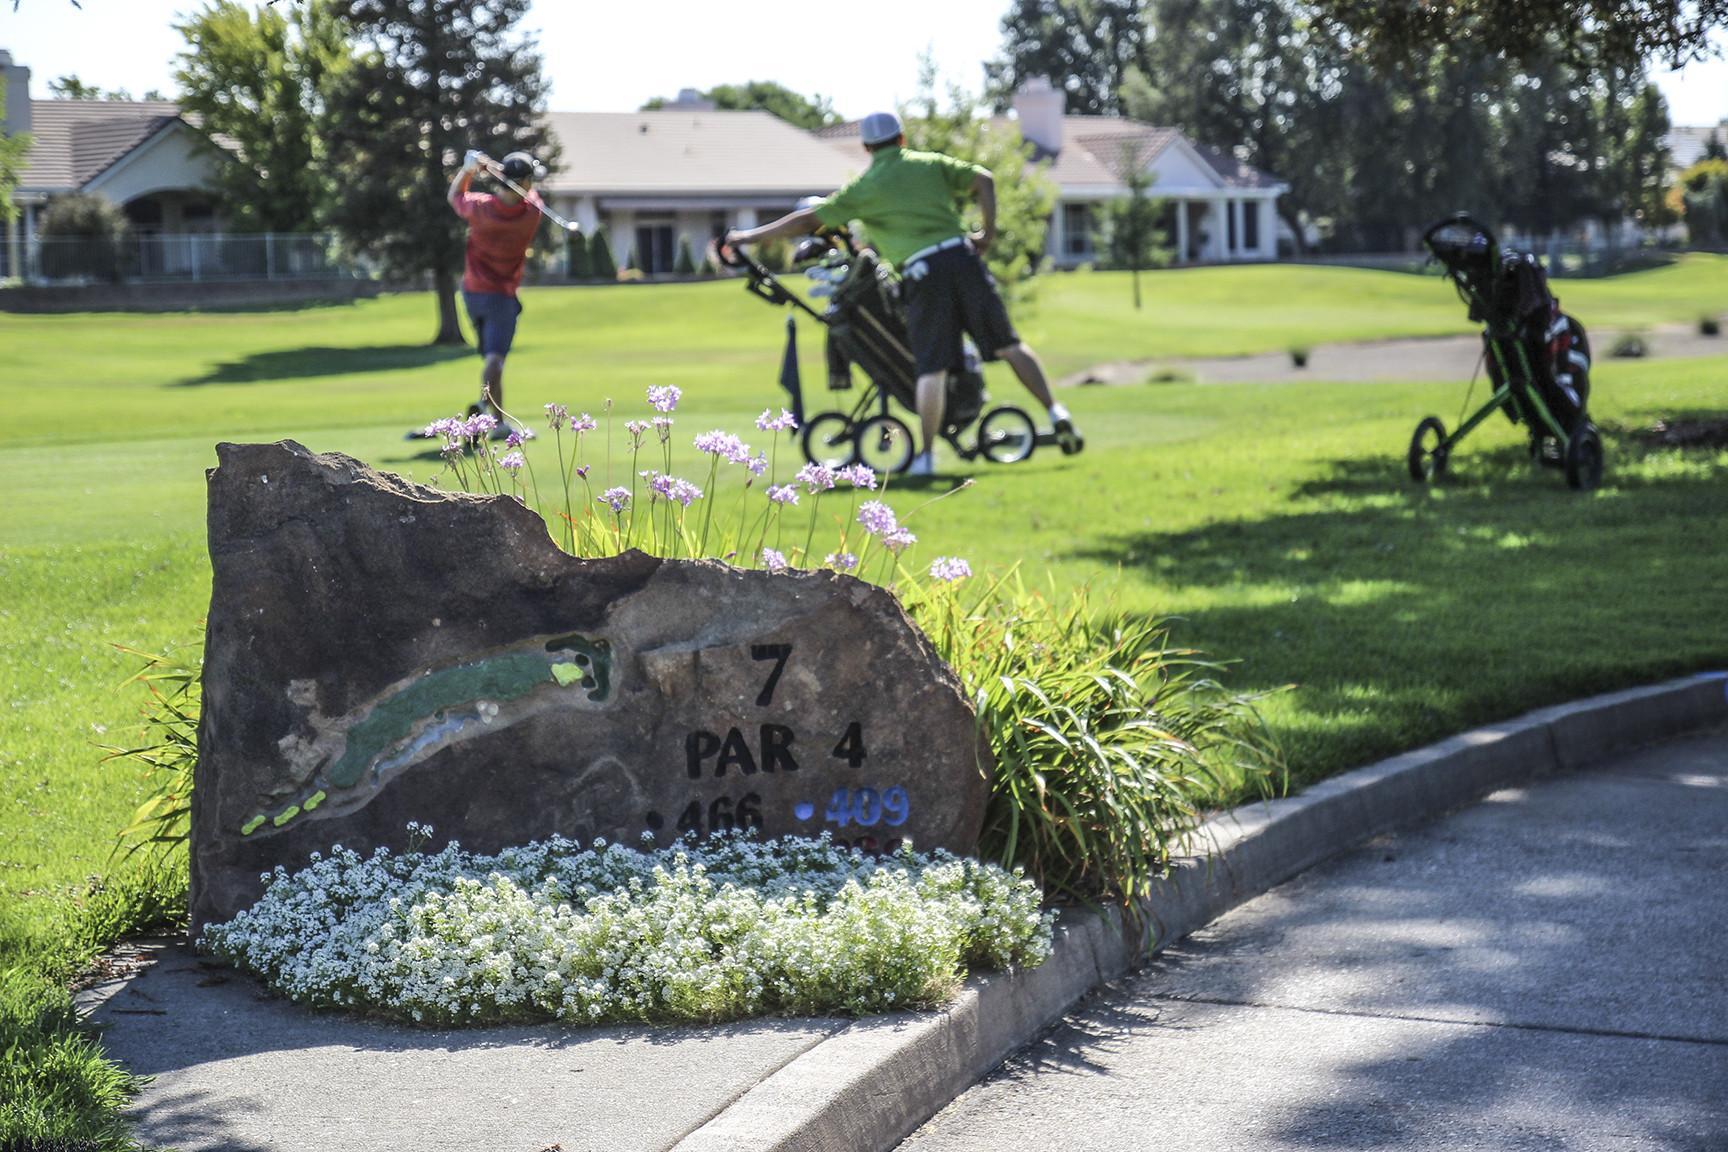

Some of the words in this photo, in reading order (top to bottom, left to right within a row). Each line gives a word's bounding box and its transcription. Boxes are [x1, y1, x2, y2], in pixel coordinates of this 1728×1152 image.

[751, 643, 793, 707] 7
[685, 723, 799, 780] PAR
[832, 721, 868, 769] 4
[676, 791, 764, 832] 466
[824, 784, 910, 828] 409
